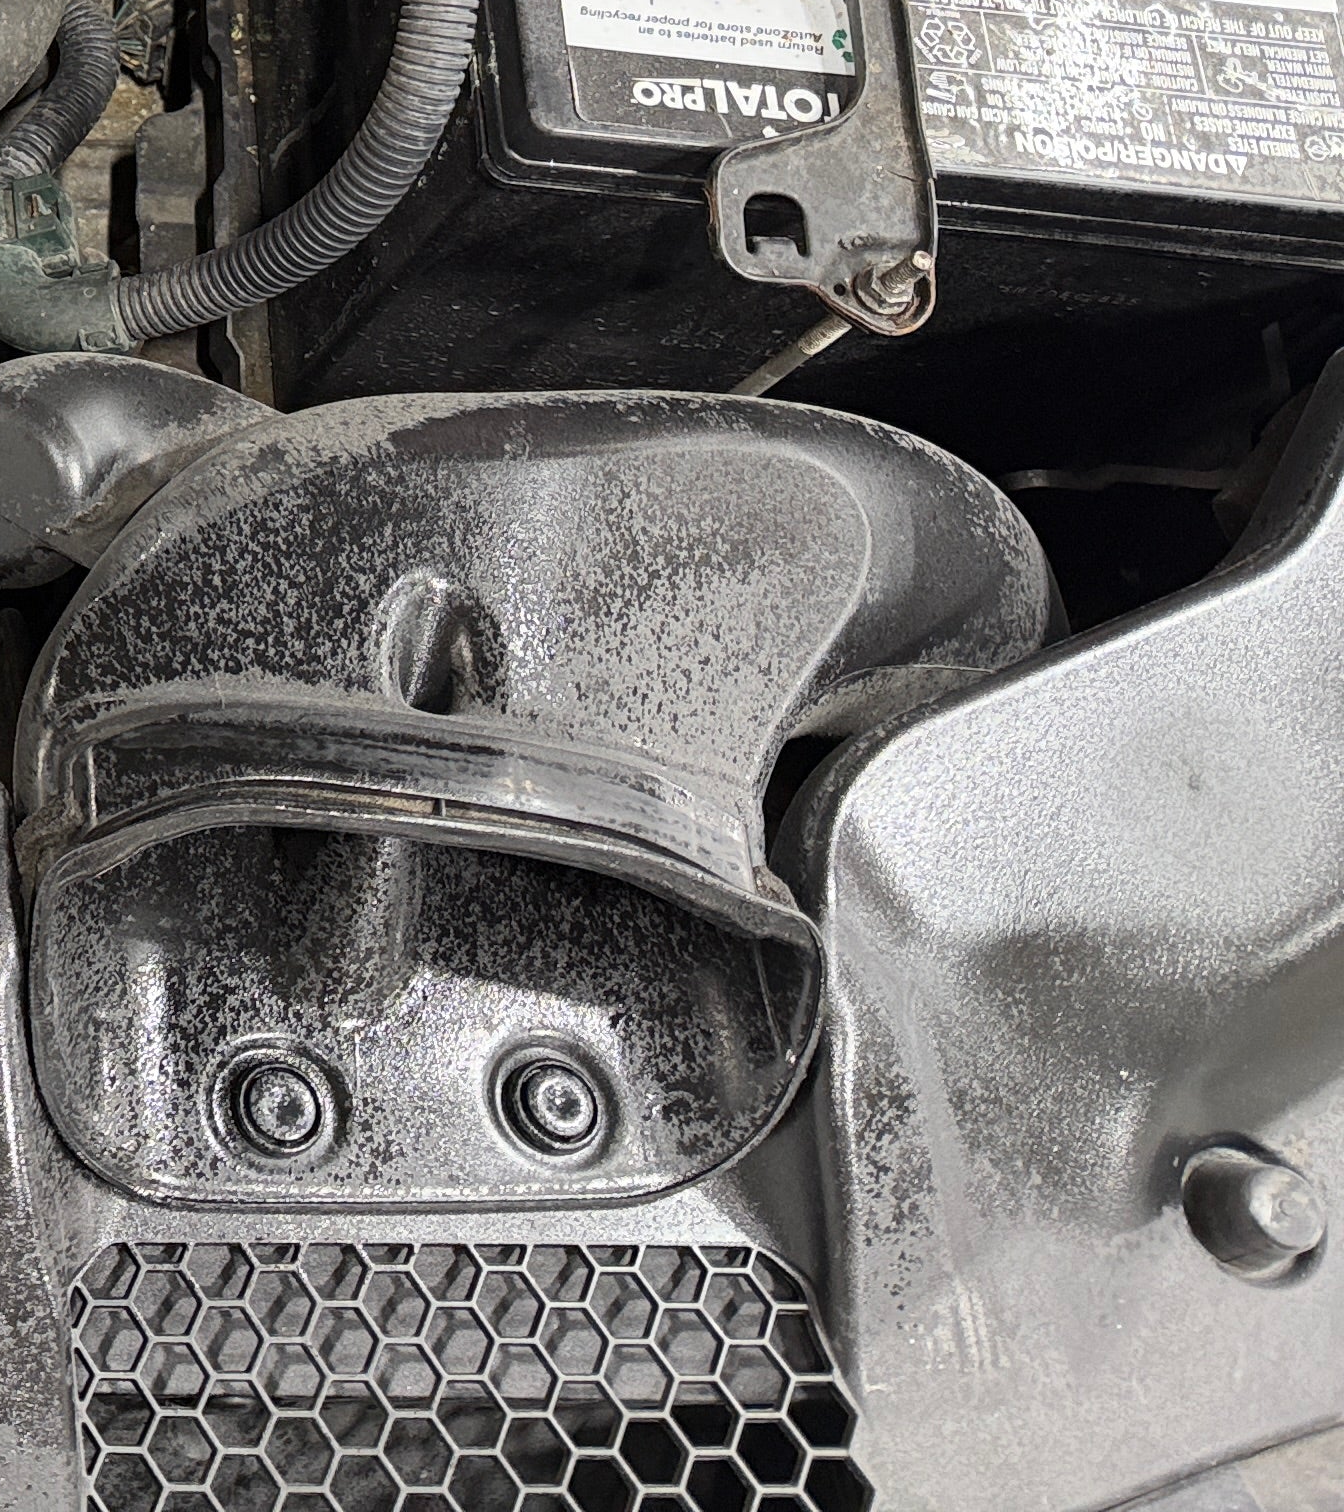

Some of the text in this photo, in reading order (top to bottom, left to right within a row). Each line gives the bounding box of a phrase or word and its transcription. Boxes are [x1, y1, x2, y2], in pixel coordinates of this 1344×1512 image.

[580, 6, 641, 23] recycling
[645, 12, 690, 28] proper
[1160, 13, 1178, 30] OF
[1181, 14, 1221, 32] REACH
[694, 20, 713, 32] for
[716, 22, 752, 34] store
[1221, 19, 1247, 35] THE
[1249, 22, 1266, 37] OF
[1269, 23, 1292, 40] OUT
[1295, 26, 1324, 43] KEEP
[638, 26, 824, 56] Return used batteries to an
[1233, 42, 1260, 57] HELP
[1260, 45, 1307, 62] MEDICAL
[1308, 49, 1329, 64] GET
[1304, 63, 1333, 77] WITH
[1266, 72, 1336, 92] IMMEDIATELY
[921, 101, 955, 118] CAUSE
[956, 105, 978, 120] CAN
[1171, 97, 1209, 114] INJURY
[1211, 101, 1226, 115] OR
[1228, 102, 1286, 122] BLINDNESS
[980, 107, 1008, 125] ACID
[1288, 108, 1321, 126] CAUSE
[1140, 121, 1166, 142] NO
[1194, 116, 1293, 140] EXPLOSIVE GASES
[1228, 136, 1300, 159] SHIELD EYES
